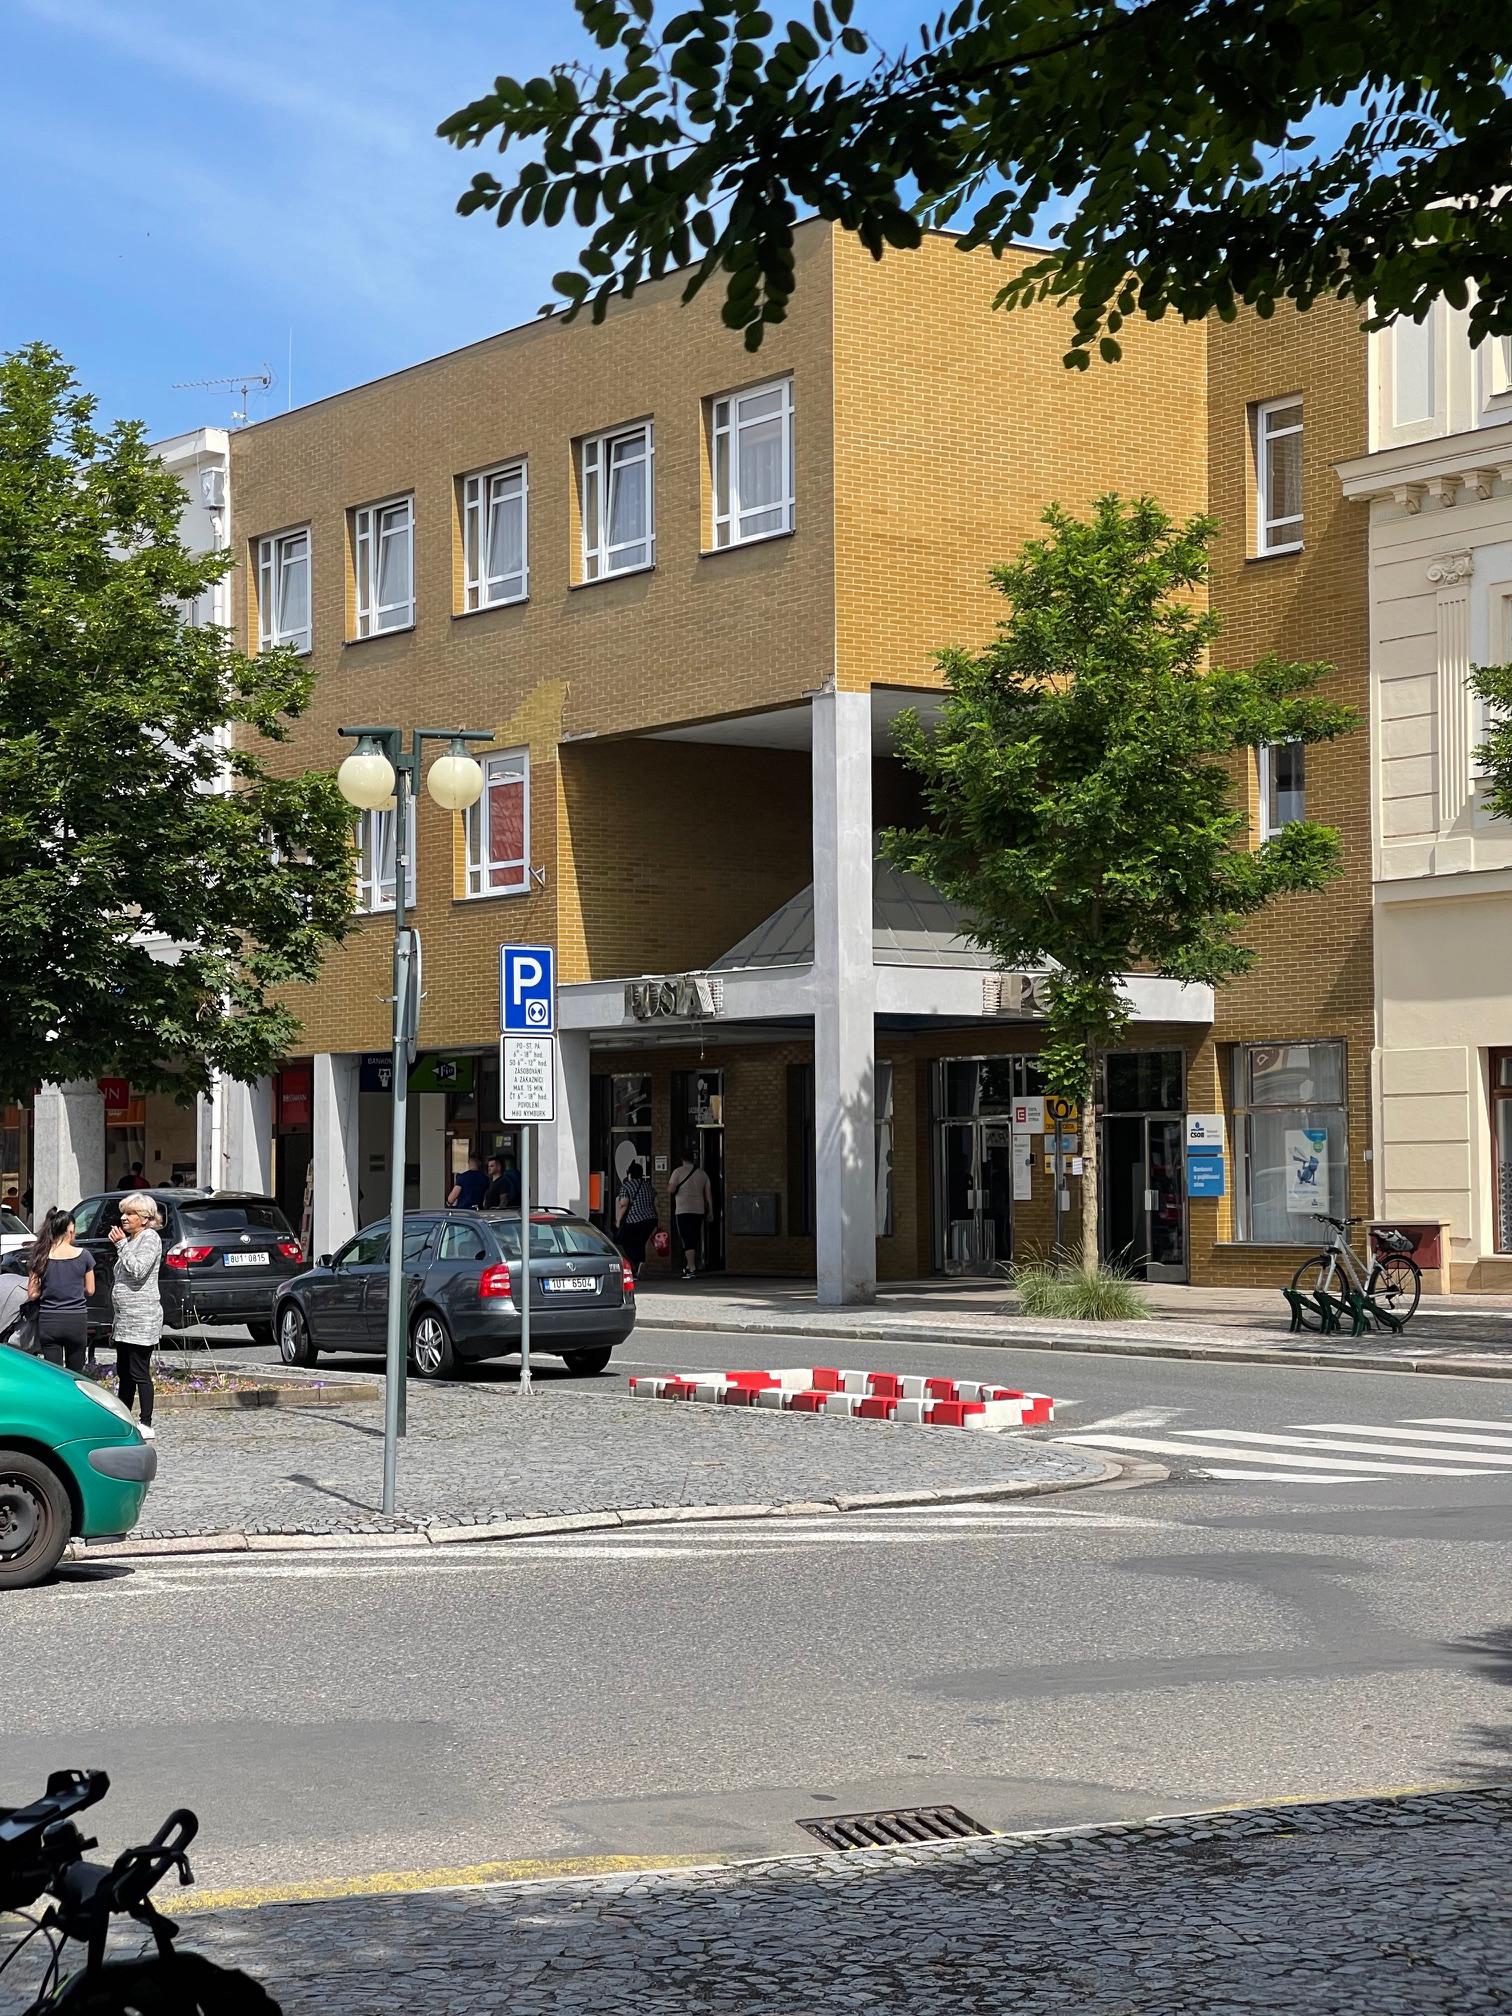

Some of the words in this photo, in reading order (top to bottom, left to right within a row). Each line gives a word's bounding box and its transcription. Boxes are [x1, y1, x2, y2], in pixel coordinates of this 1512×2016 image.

[513, 957, 543, 1005] P
[248, 1253, 266, 1262] 0815
[572, 1277, 592, 1288] 6504
